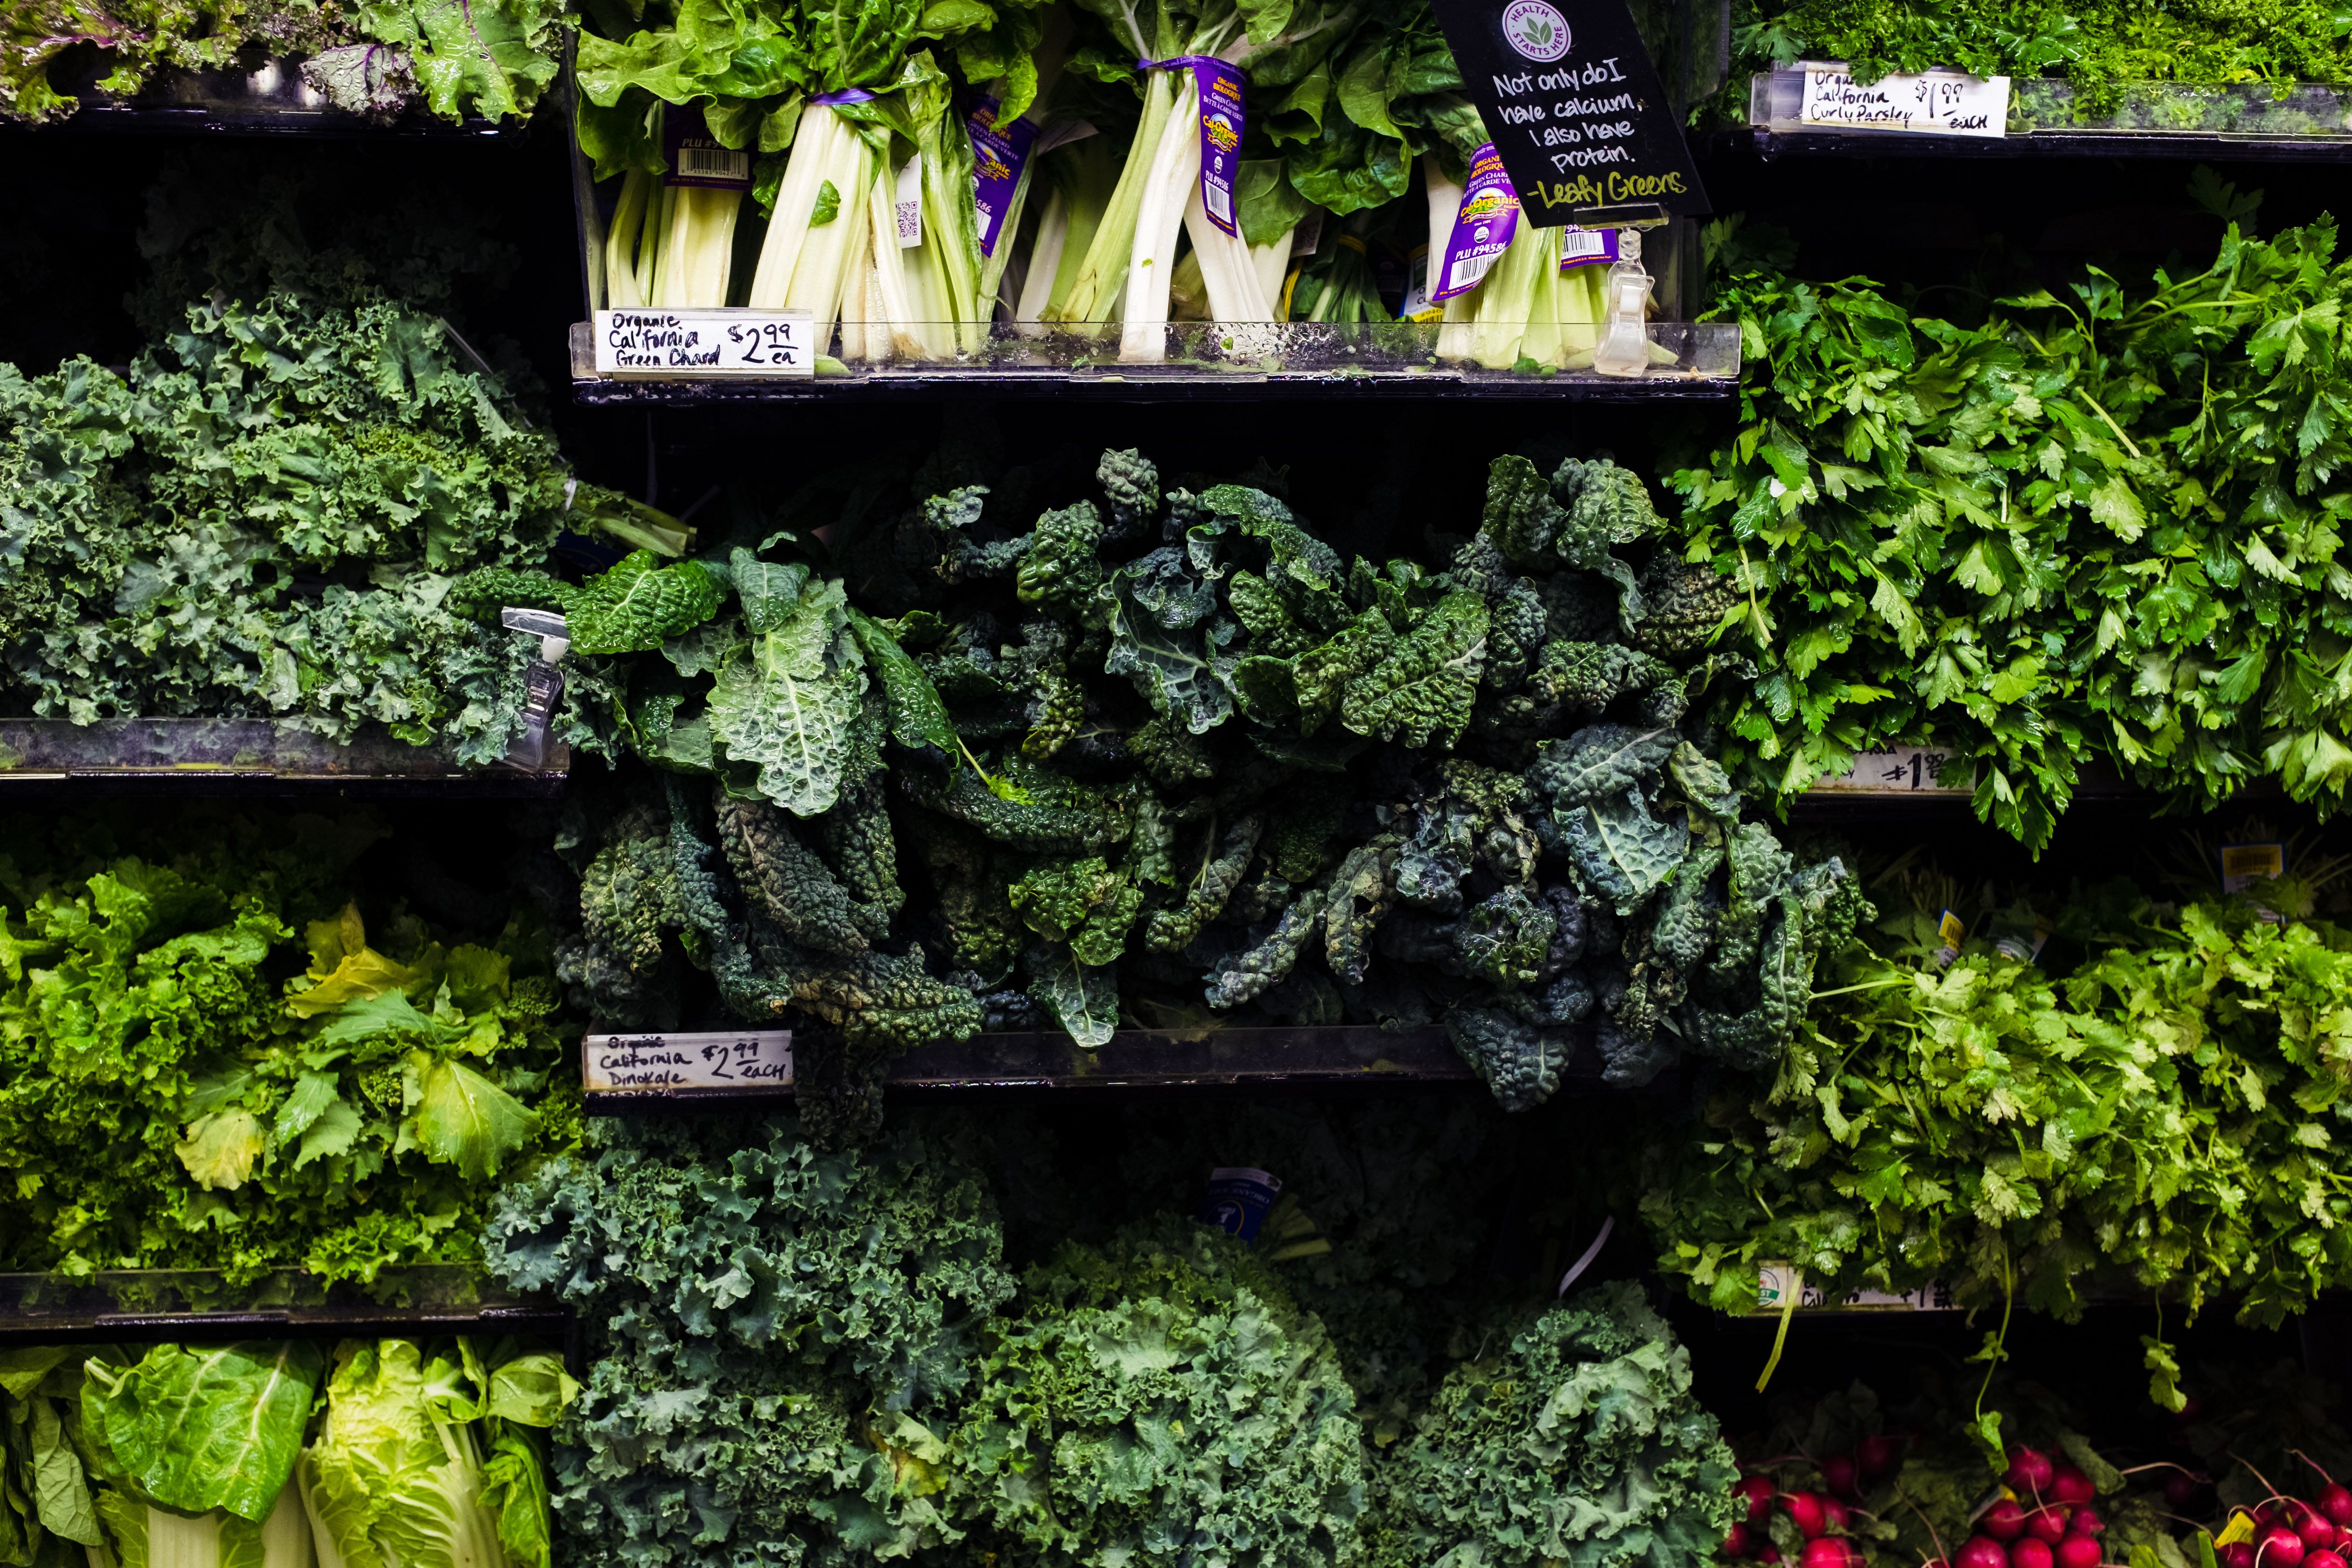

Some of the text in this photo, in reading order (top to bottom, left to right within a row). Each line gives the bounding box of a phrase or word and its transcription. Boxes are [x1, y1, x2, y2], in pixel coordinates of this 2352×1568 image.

[1511, 5, 1549, 22] HEALTH
[1513, 26, 1563, 55] STARTS HERE
[1217, 76, 1238, 92] ORGANIC
[1493, 57, 1626, 97] Not only do I
[1213, 82, 1241, 102] BIOLOGIQUE
[1816, 86, 1890, 105] California
[1498, 105, 1546, 124] have
[1811, 104, 1853, 122] Curly
[1857, 105, 1913, 129] Parsley
[968, 120, 988, 136] GREEN
[988, 132, 1010, 149] CHARD
[972, 112, 1012, 141] BIOLOQUE
[1203, 115, 1238, 142] Cal-Organic
[1529, 121, 1635, 147] I also have
[682, 138, 702, 147] PLU
[980, 134, 999, 150] CARDE
[1000, 146, 1019, 161] VERTE
[1470, 161, 1505, 179] BIOLOGIQU
[1474, 155, 1500, 169] ORGANI
[1550, 146, 1636, 174] protein.
[1479, 178, 1500, 188] CARDE
[1608, 172, 1687, 201] Greens
[1455, 248, 1471, 261] PLU
[612, 313, 680, 337] Organic
[616, 344, 797, 366] Green Chard ea
[600, 1052, 693, 1069] California
